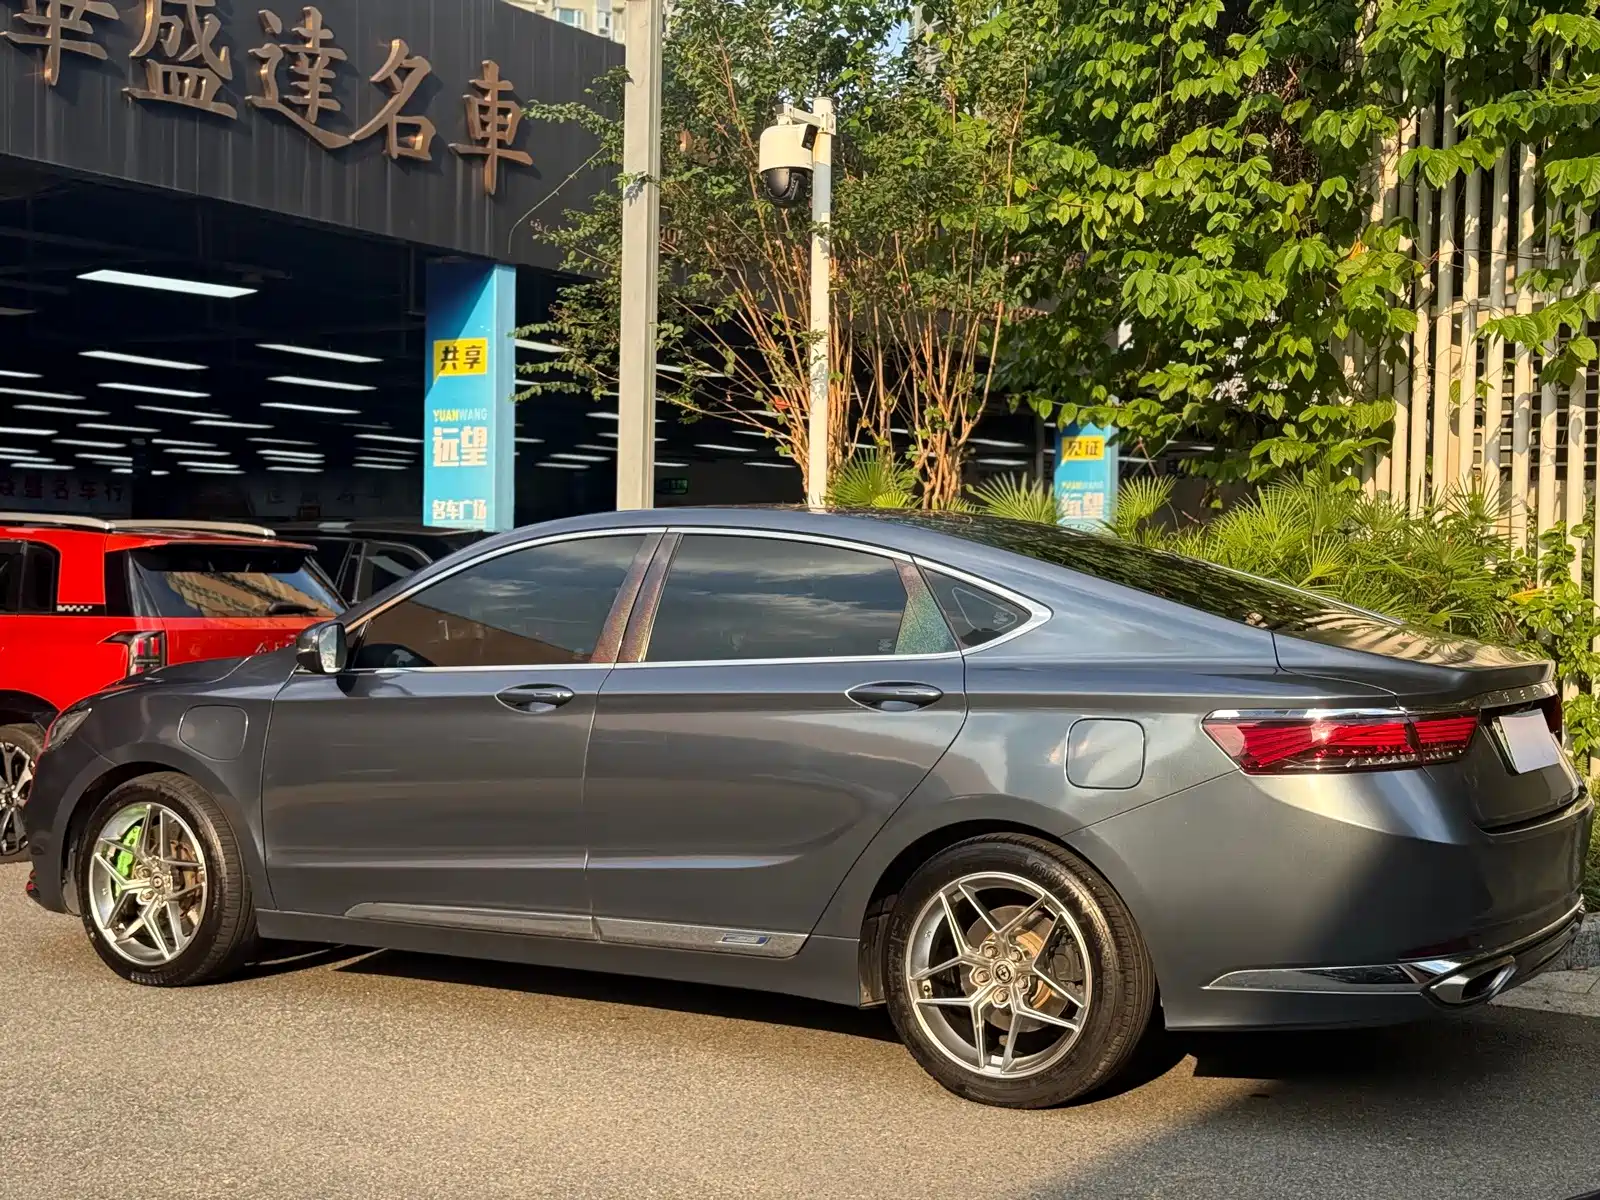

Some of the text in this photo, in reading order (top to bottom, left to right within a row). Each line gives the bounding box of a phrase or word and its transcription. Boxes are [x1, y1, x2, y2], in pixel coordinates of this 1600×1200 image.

[440, 345, 483, 371] 共享
[432, 408, 488, 422] YUANWANG
[432, 426, 488, 467] 远望
[432, 499, 487, 520] 名车广场
